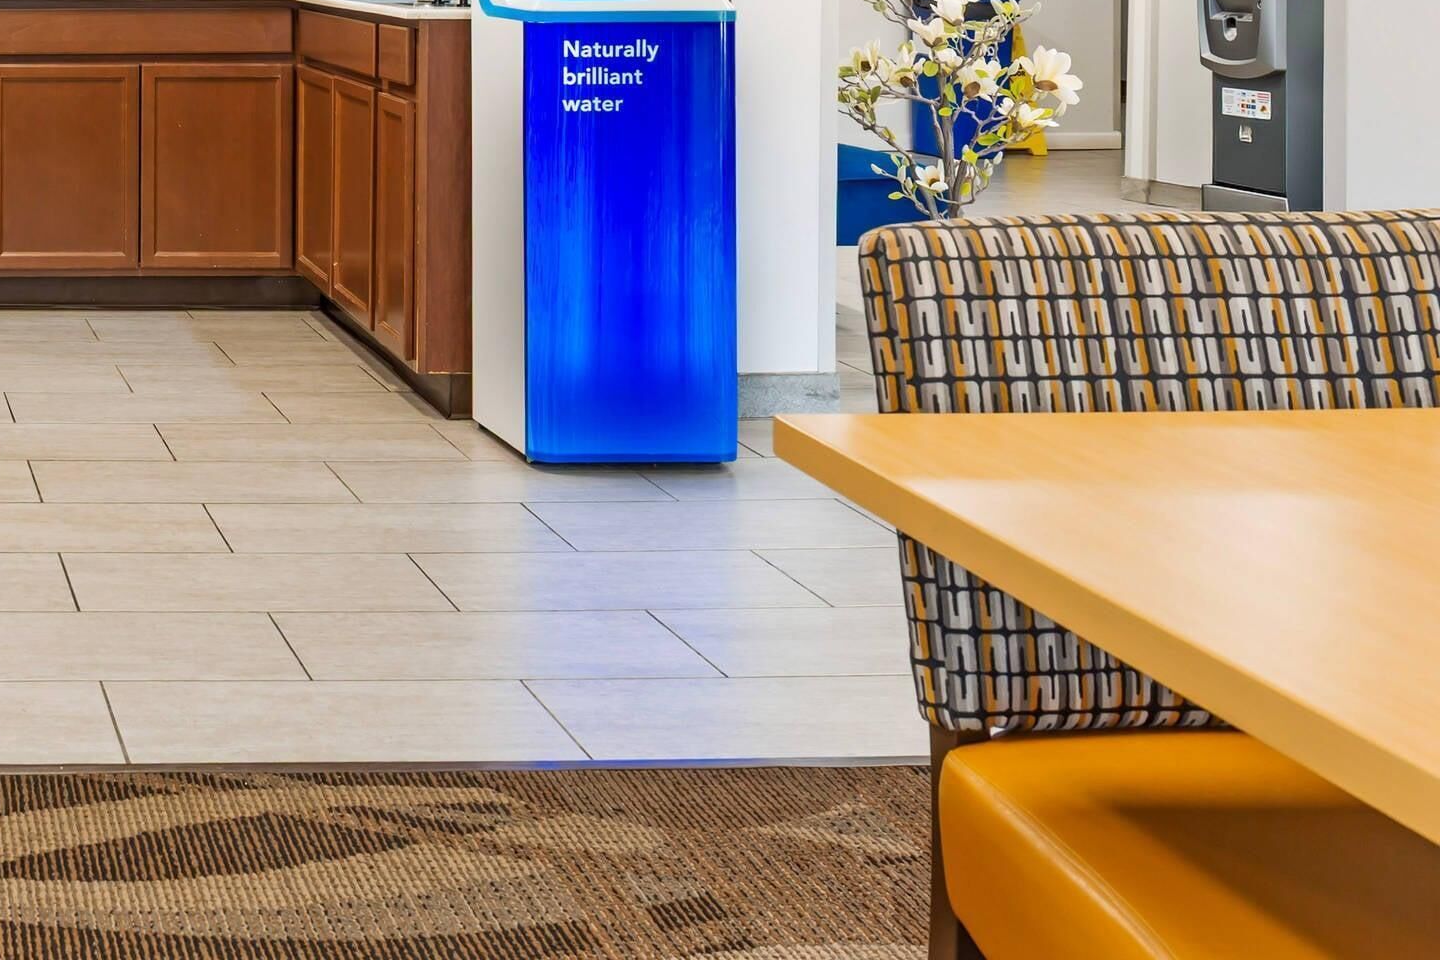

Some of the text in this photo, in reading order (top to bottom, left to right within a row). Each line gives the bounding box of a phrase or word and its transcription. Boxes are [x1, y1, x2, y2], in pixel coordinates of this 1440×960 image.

[563, 38, 659, 63] Naturally
[562, 66, 644, 85] brilliant
[561, 96, 624, 112] water
